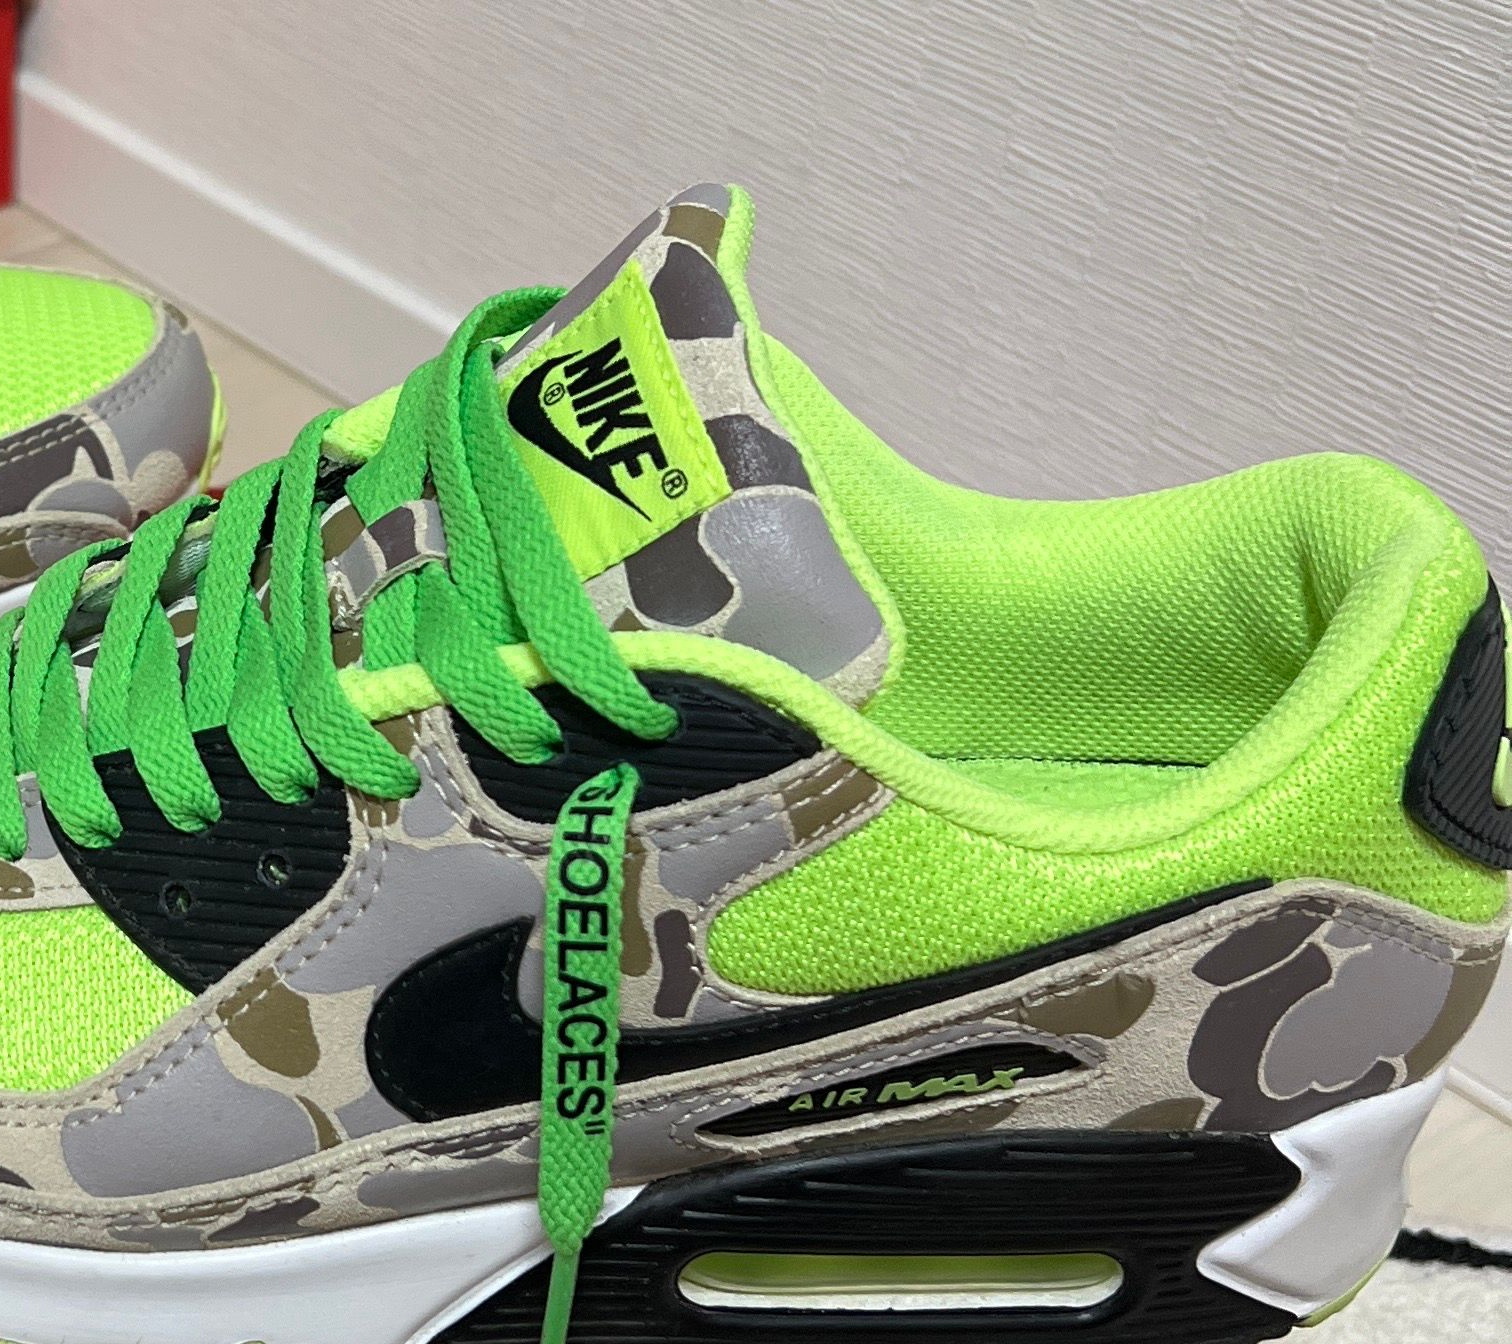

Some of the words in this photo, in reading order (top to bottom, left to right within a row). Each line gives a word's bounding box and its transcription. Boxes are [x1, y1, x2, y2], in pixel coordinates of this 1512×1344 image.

[563, 336, 670, 479] NIKE
[788, 1087, 869, 1113] AIR
[876, 1066, 1025, 1104] MAX
